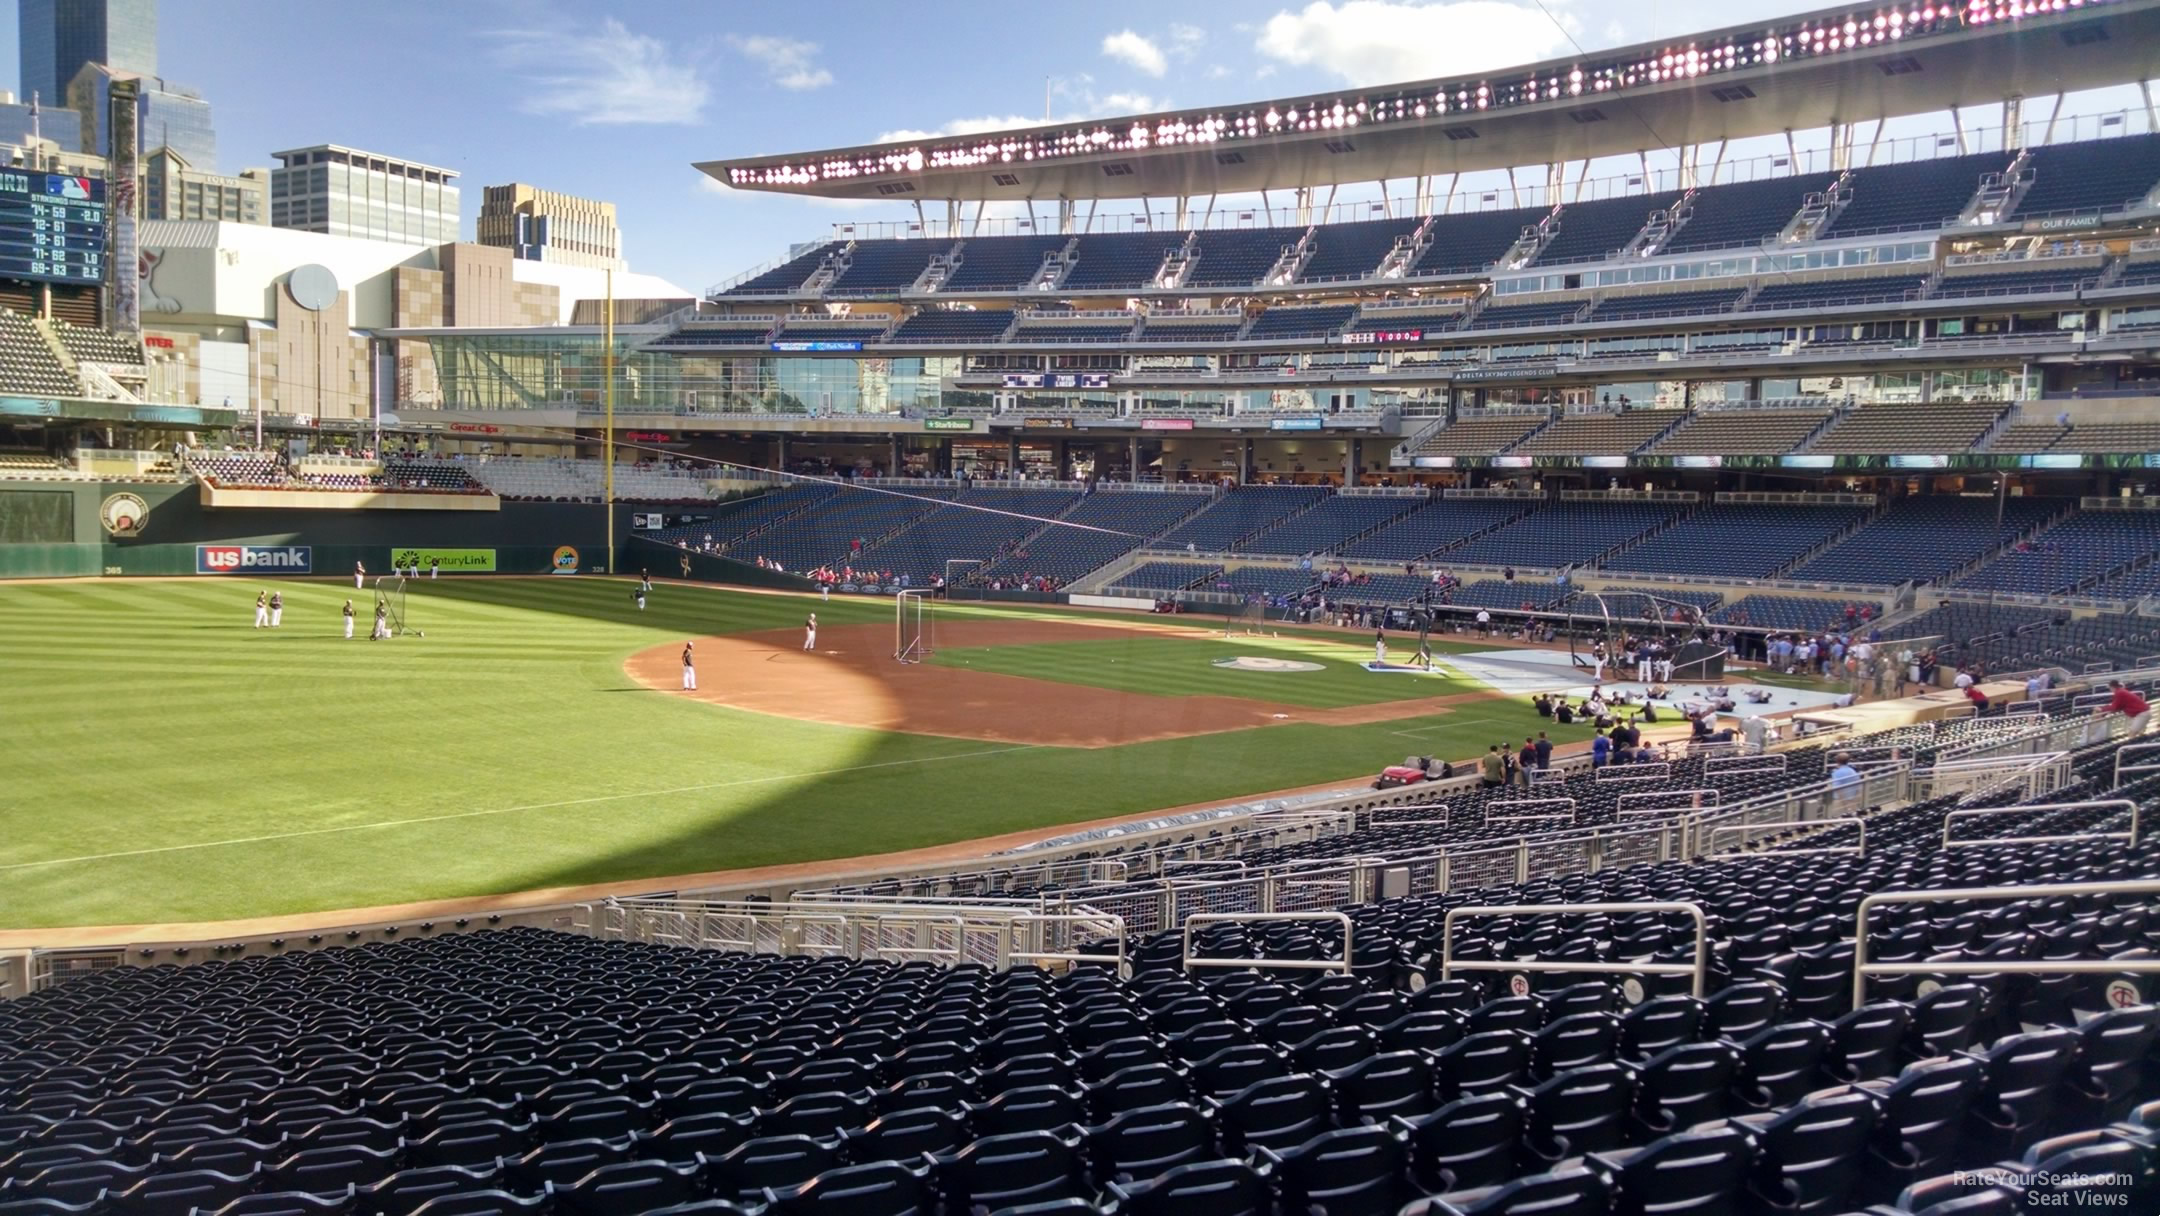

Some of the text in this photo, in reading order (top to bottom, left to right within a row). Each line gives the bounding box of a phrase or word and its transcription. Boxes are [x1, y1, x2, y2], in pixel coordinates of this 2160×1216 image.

[31, 193, 69, 206] STANDINGS
[53, 220, 66, 233] 61
[2042, 219, 2063, 229] OUR
[2065, 216, 2098, 227] FAMILY
[53, 235, 66, 247] 61
[1509, 369, 1537, 377] LEGENDS
[450, 423, 499, 435] Great Clips
[934, 421, 970, 429] StarTribune
[423, 555, 487, 567] CnturyLink
